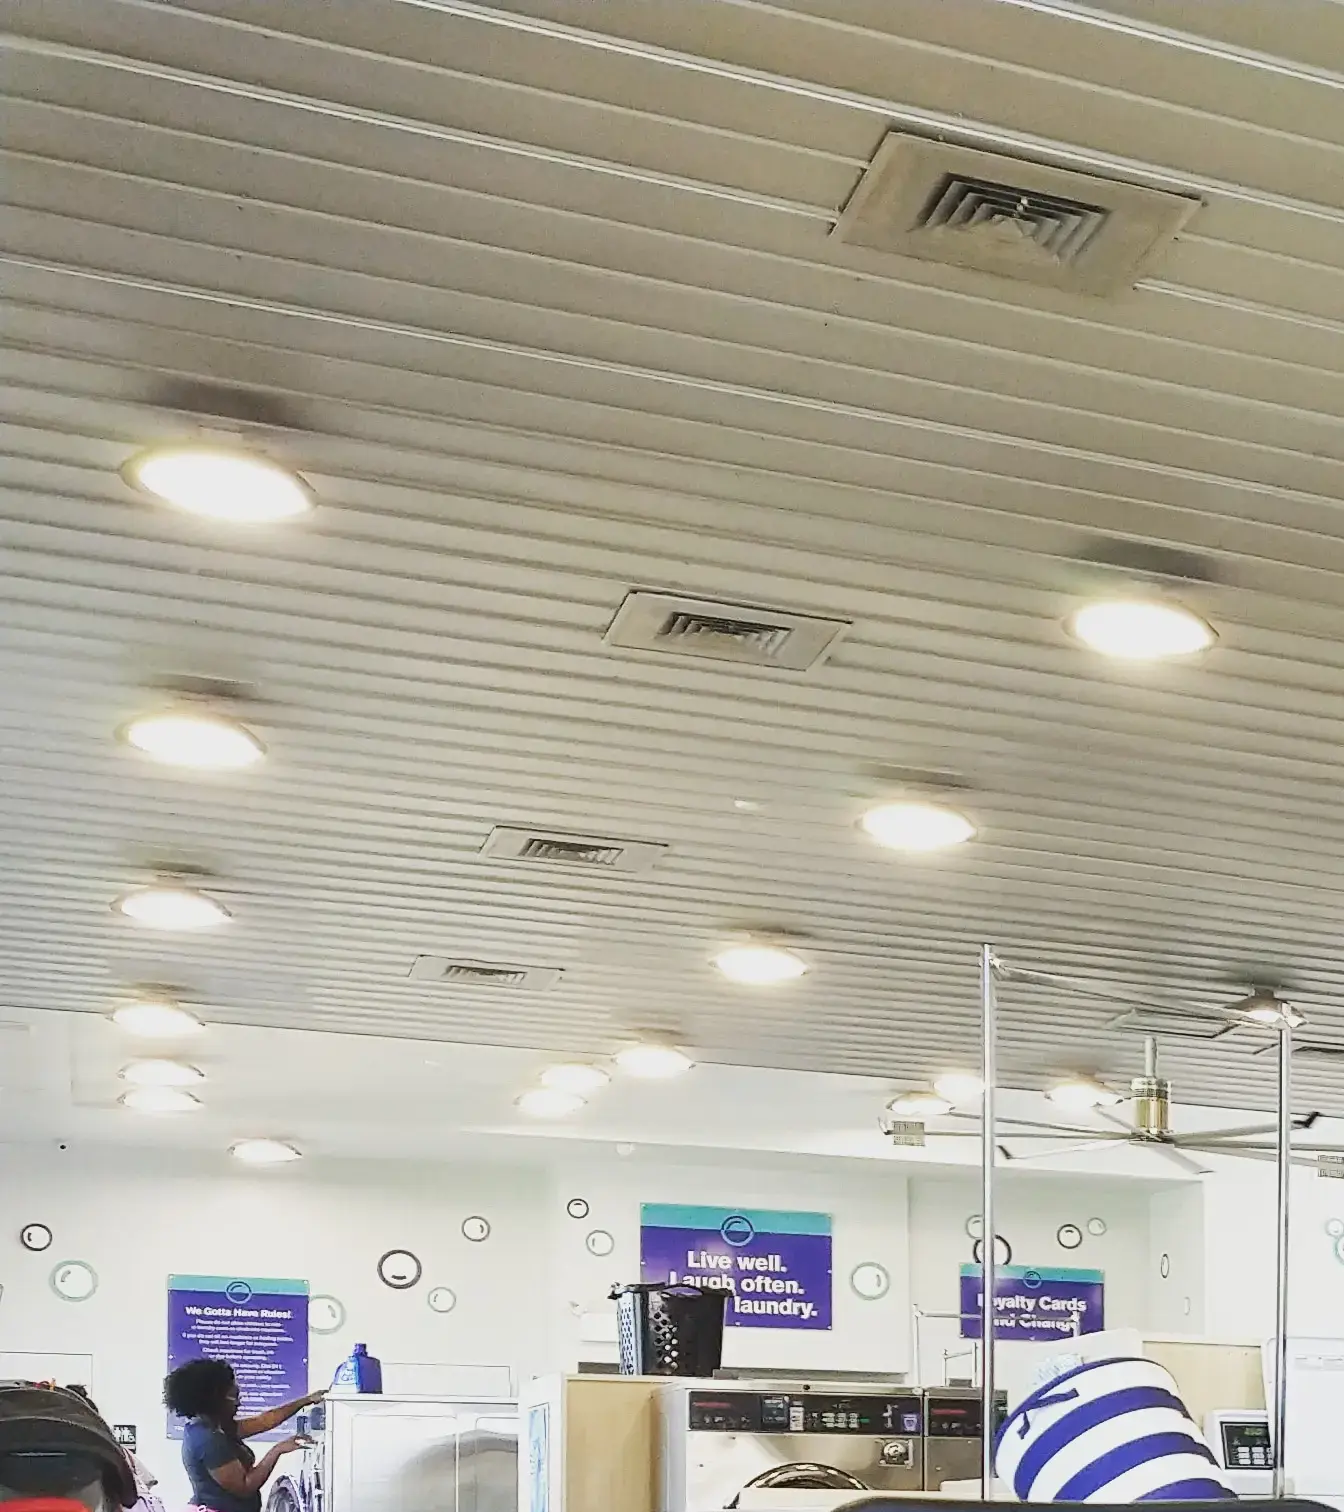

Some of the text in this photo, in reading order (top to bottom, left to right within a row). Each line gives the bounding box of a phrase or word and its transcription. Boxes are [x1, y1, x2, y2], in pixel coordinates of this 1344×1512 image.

[687, 1250, 788, 1272] Live well.
[740, 1276, 805, 1295] often.
[185, 1306, 202, 1315] We
[203, 1307, 232, 1317] Gotta
[234, 1308, 259, 1318] Have
[734, 1297, 818, 1319] laundry.
[1039, 1296, 1087, 1312] Cards
